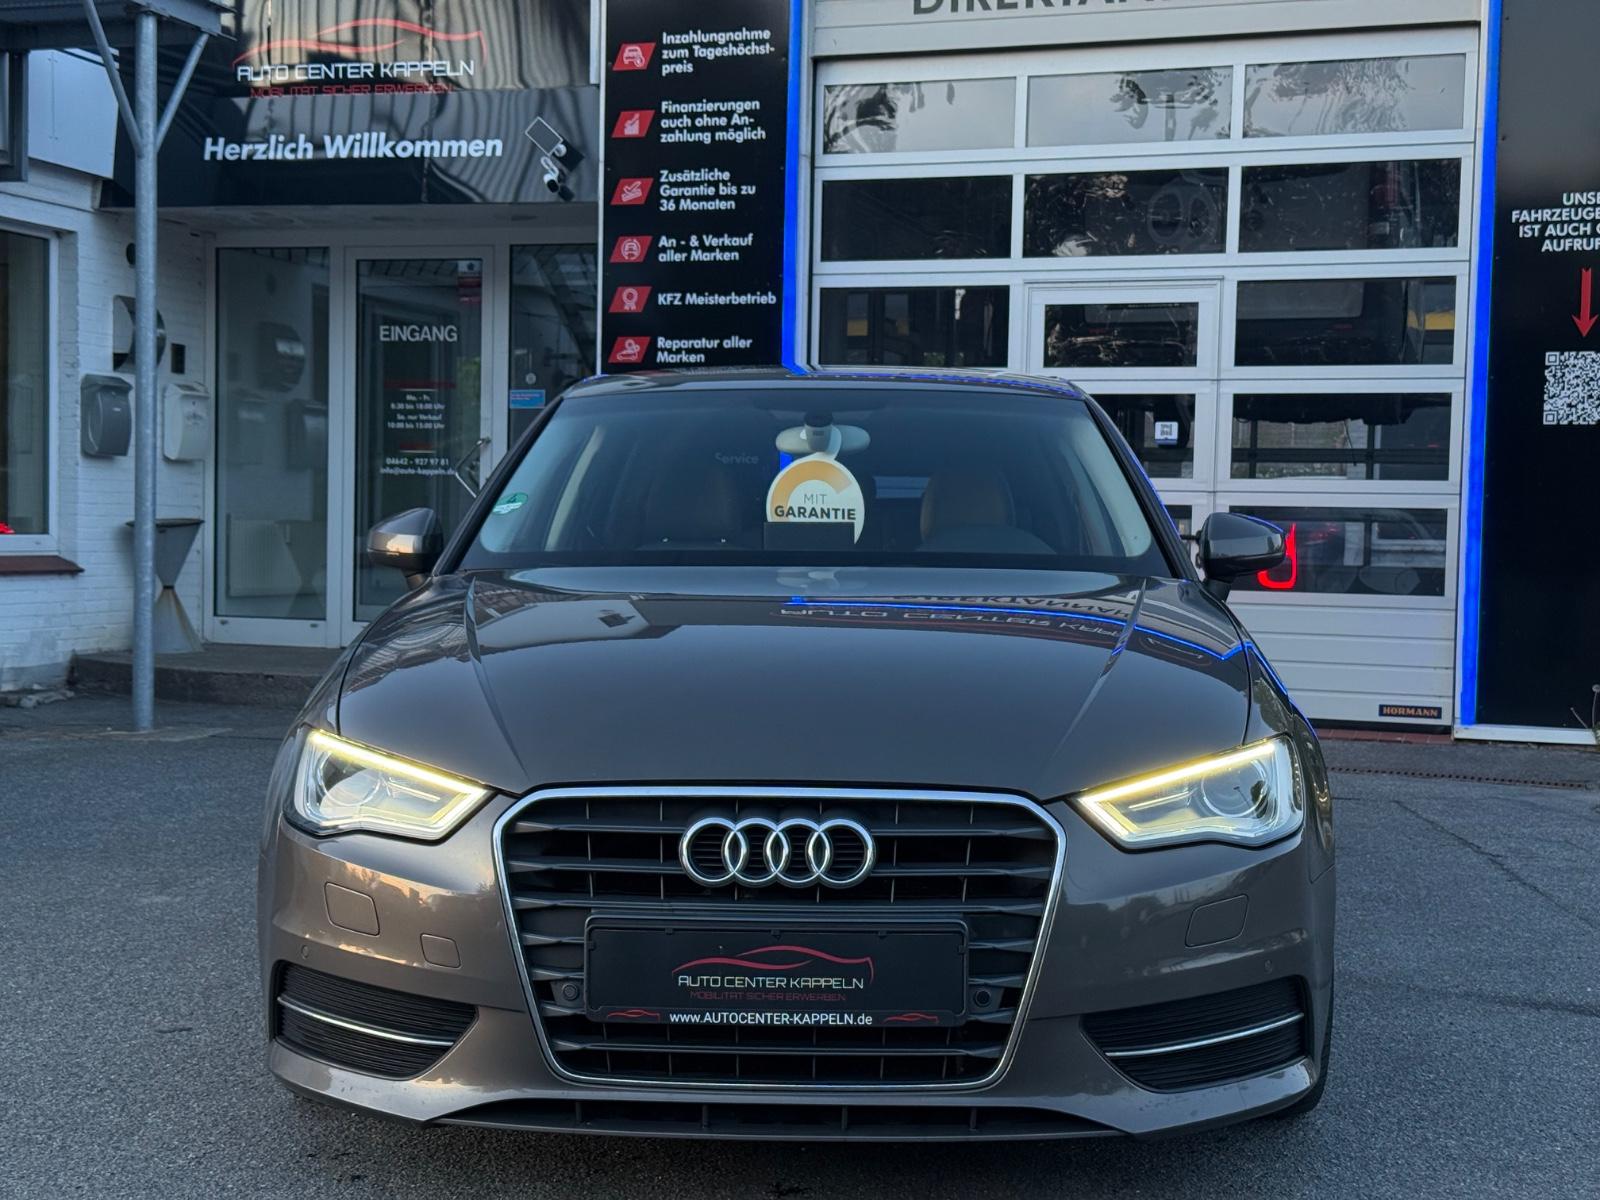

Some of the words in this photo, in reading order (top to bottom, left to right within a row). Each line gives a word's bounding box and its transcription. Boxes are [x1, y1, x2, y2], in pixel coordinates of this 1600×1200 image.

[662, 27, 771, 44] Inzahlungnahme
[661, 48, 690, 59] zum
[693, 42, 775, 60] Tageshöchst-
[236, 64, 289, 82] AUTO
[294, 62, 374, 80] CENTER
[379, 60, 474, 78] KAPPELN
[661, 60, 693, 76] preis
[661, 99, 759, 114] Finanzierungen
[660, 115, 692, 129] auch
[694, 115, 728, 127] ohne
[730, 113, 755, 126] An-
[660, 129, 712, 144] zahlung
[715, 127, 767, 144] möglich
[203, 133, 314, 161] Herzlich
[323, 131, 503, 159] Willkommen
[659, 168, 731, 183] Zusätzliche
[659, 183, 716, 198] Garantie
[718, 182, 737, 196] bis
[740, 184, 757, 196] zu
[659, 199, 676, 212] 36
[679, 198, 736, 211] Monaten
[1519, 225, 1541, 238] IST
[1544, 223, 1592, 236] AUCH
[689, 236, 700, 248] &
[703, 233, 754, 247] Verkauf
[658, 249, 688, 262] aller
[690, 249, 740, 262] Marken
[658, 293, 682, 306] KFZ
[685, 291, 777, 306] Meisterbetrieb
[379, 325, 458, 342] EINGANG
[657, 336, 720, 351] Reparatur
[723, 335, 753, 348] aller
[656, 350, 705, 364] Marken
[803, 493, 828, 505] MIT
[774, 505, 857, 520] GARANTIE
[678, 975, 721, 987] AUTO
[724, 976, 787, 988] CENTER
[790, 977, 864, 989] KAPPELN
[747, 992, 785, 1000] SICHER
[786, 993, 847, 1001] ERWERBEN
[669, 1011, 873, 1025] www.AUTOCENTER-KAPPELN.de
